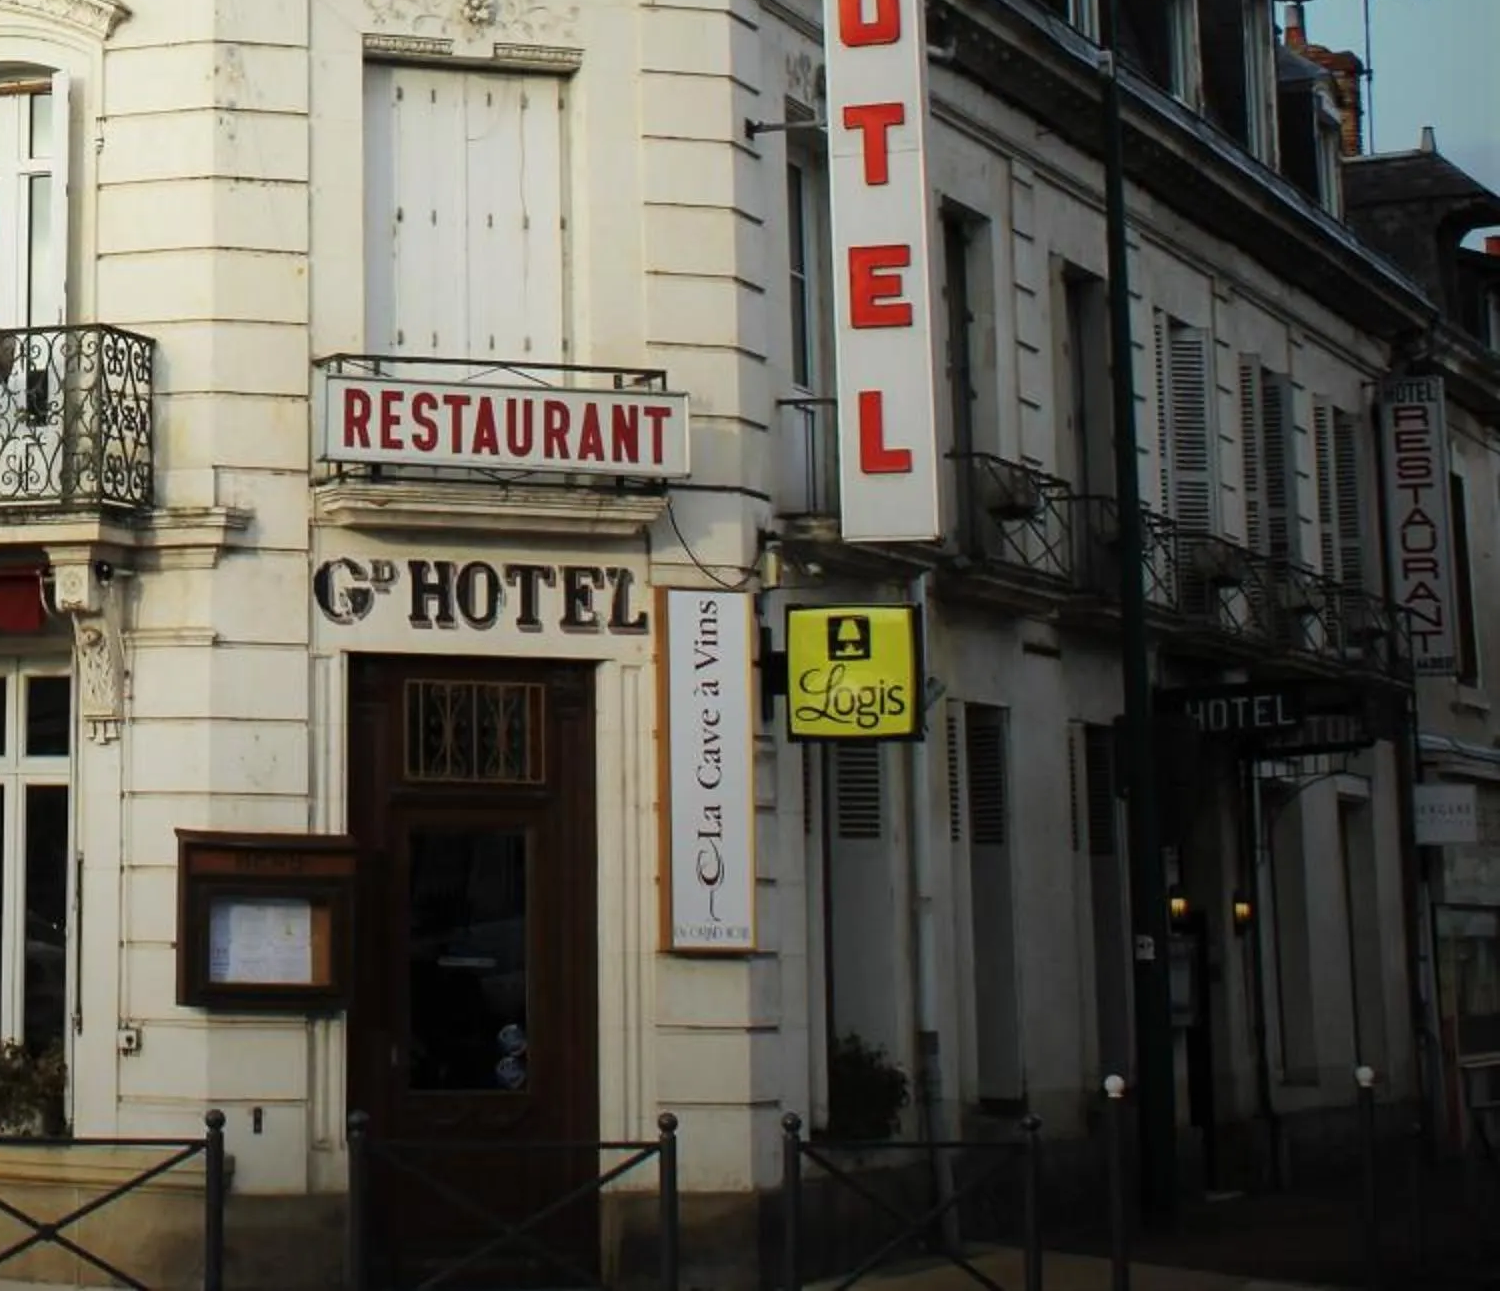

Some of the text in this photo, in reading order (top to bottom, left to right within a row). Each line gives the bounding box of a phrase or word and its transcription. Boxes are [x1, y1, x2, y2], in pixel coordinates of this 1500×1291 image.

[343, 387, 672, 465] RESTAURANT
[1392, 406, 1443, 654] RESTAURANT
[407, 559, 650, 635] HOTEL
[694, 599, 719, 671] Vins
[693, 680, 721, 697] à
[795, 663, 905, 729] Logis
[1184, 693, 1297, 731] HOTEL
[695, 707, 722, 790] Cave
